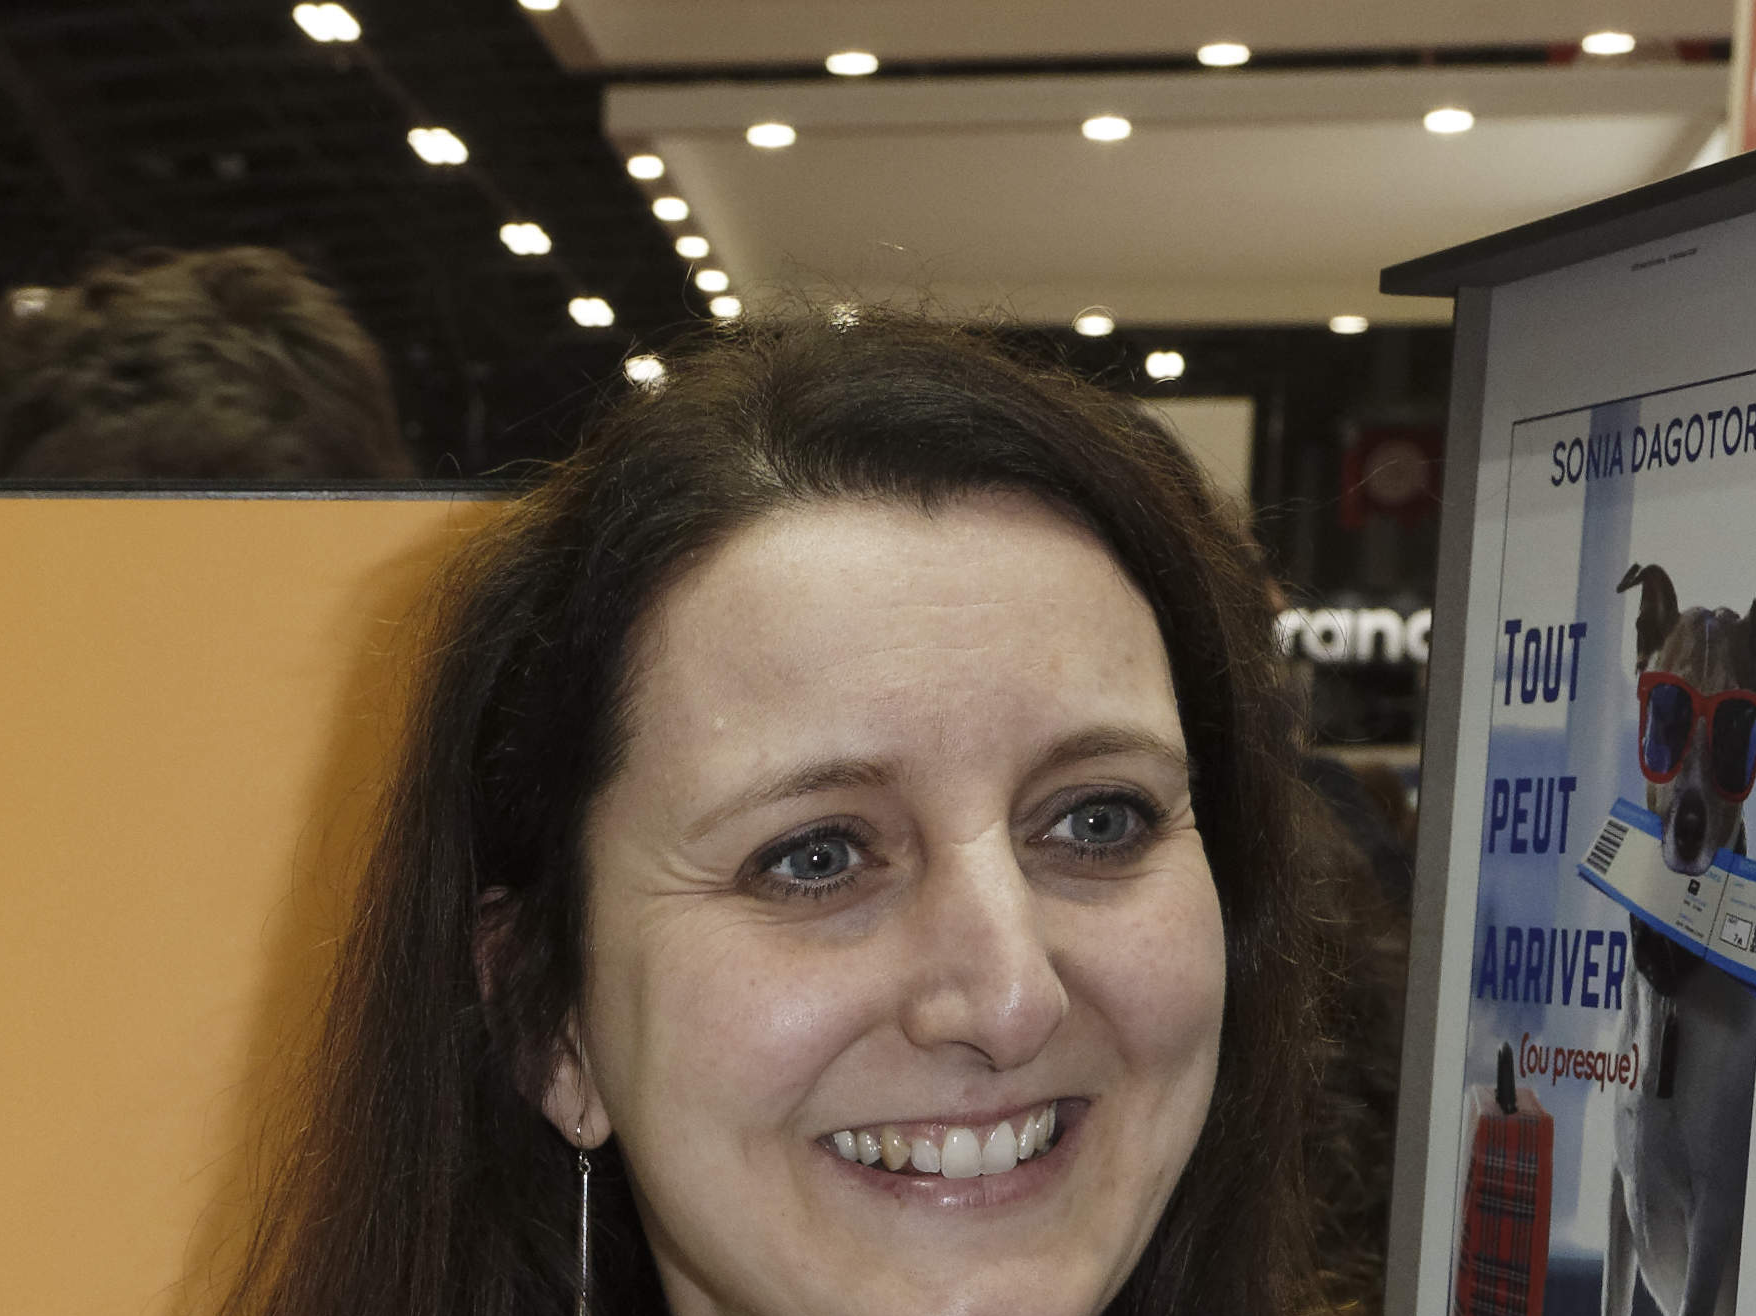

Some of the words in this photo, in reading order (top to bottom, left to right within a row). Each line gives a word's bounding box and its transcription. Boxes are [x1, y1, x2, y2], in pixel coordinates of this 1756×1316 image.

[1551, 432, 1624, 487] SONIA
[1503, 618, 1587, 706] TOUT
[1487, 776, 1577, 855] PEUT
[1476, 925, 1628, 1010] ARRIVER
[1519, 1032, 1549, 1076] (ou
[1552, 1043, 1640, 1094] presque)
